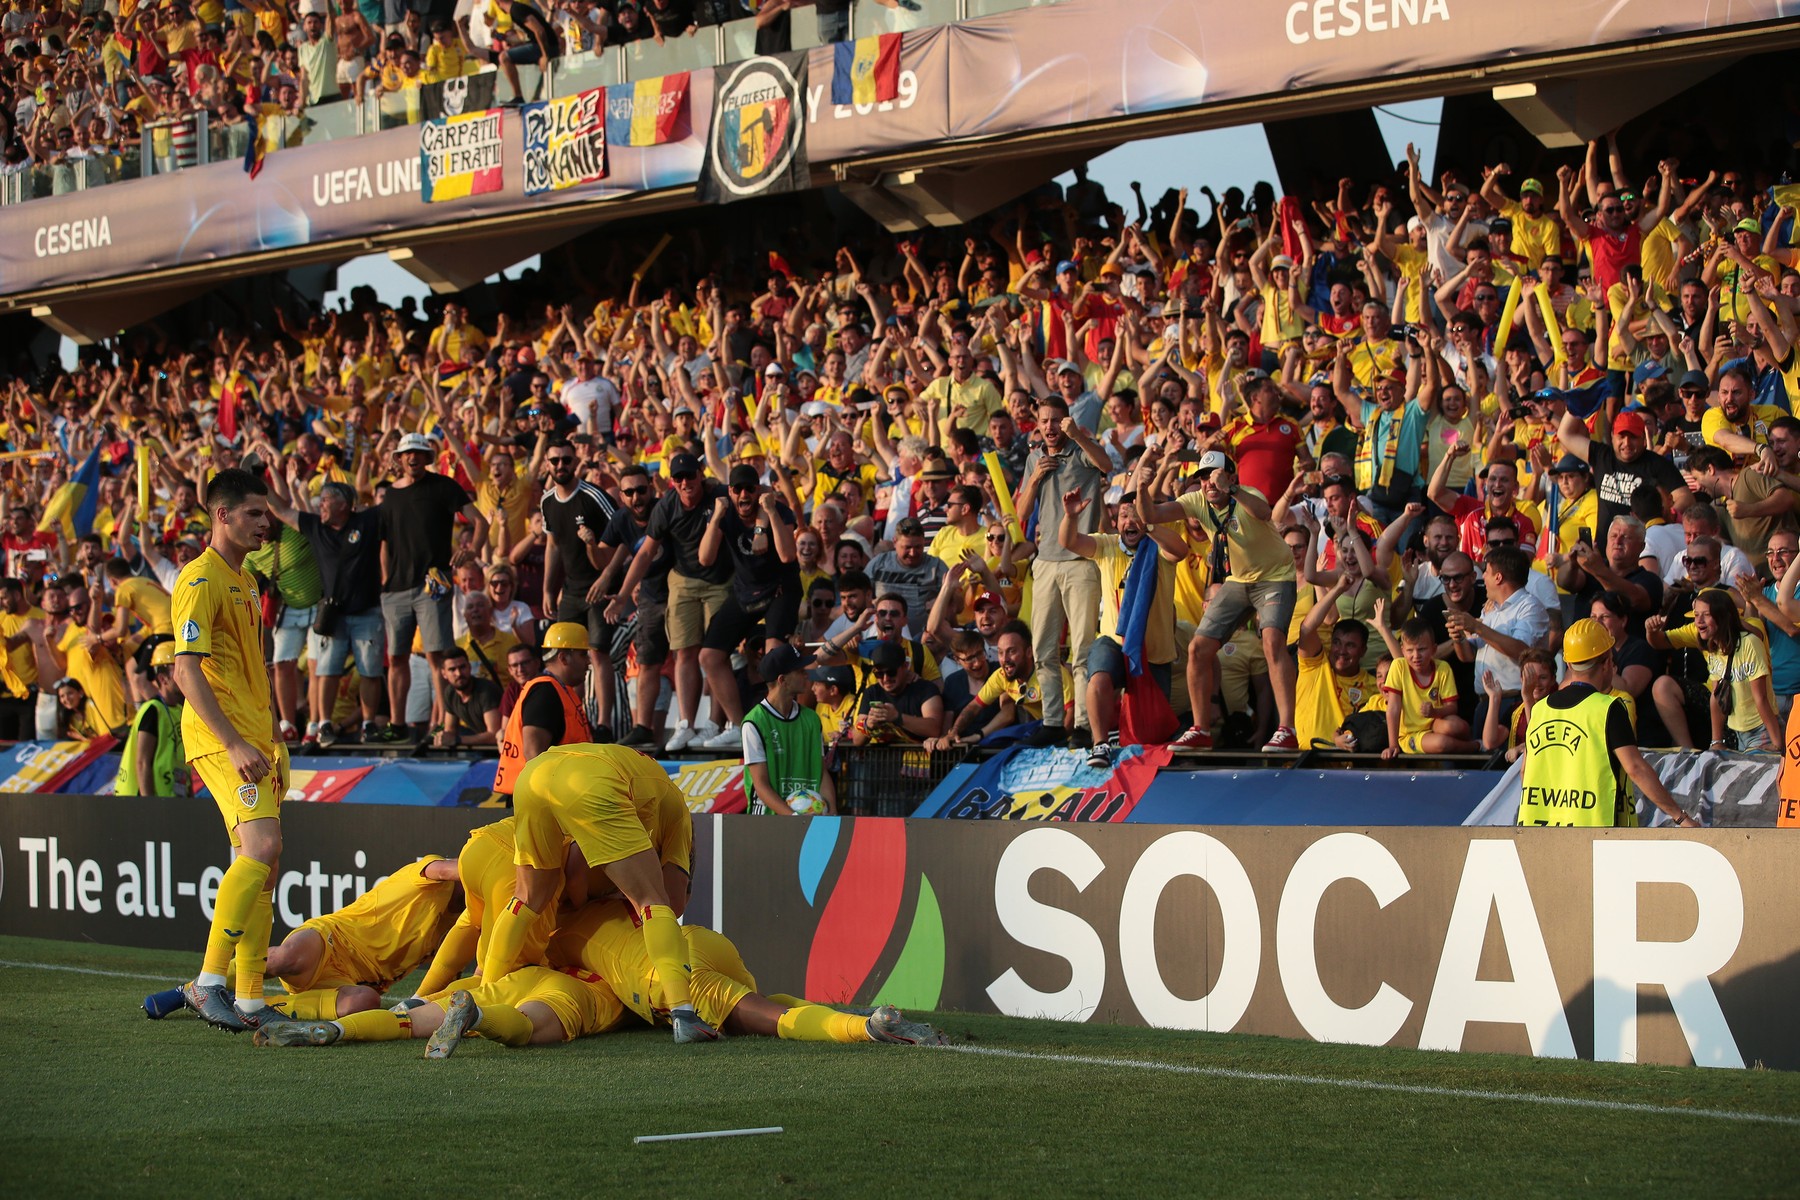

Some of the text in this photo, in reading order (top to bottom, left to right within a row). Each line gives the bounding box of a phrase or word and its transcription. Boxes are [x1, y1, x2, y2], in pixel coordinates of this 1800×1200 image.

[313, 166, 373, 206] UEFA
[34, 215, 112, 258] CESENA
[1530, 725, 1582, 753] UEFA
[19, 836, 103, 914] The
[985, 828, 1746, 1068] SOCAR
